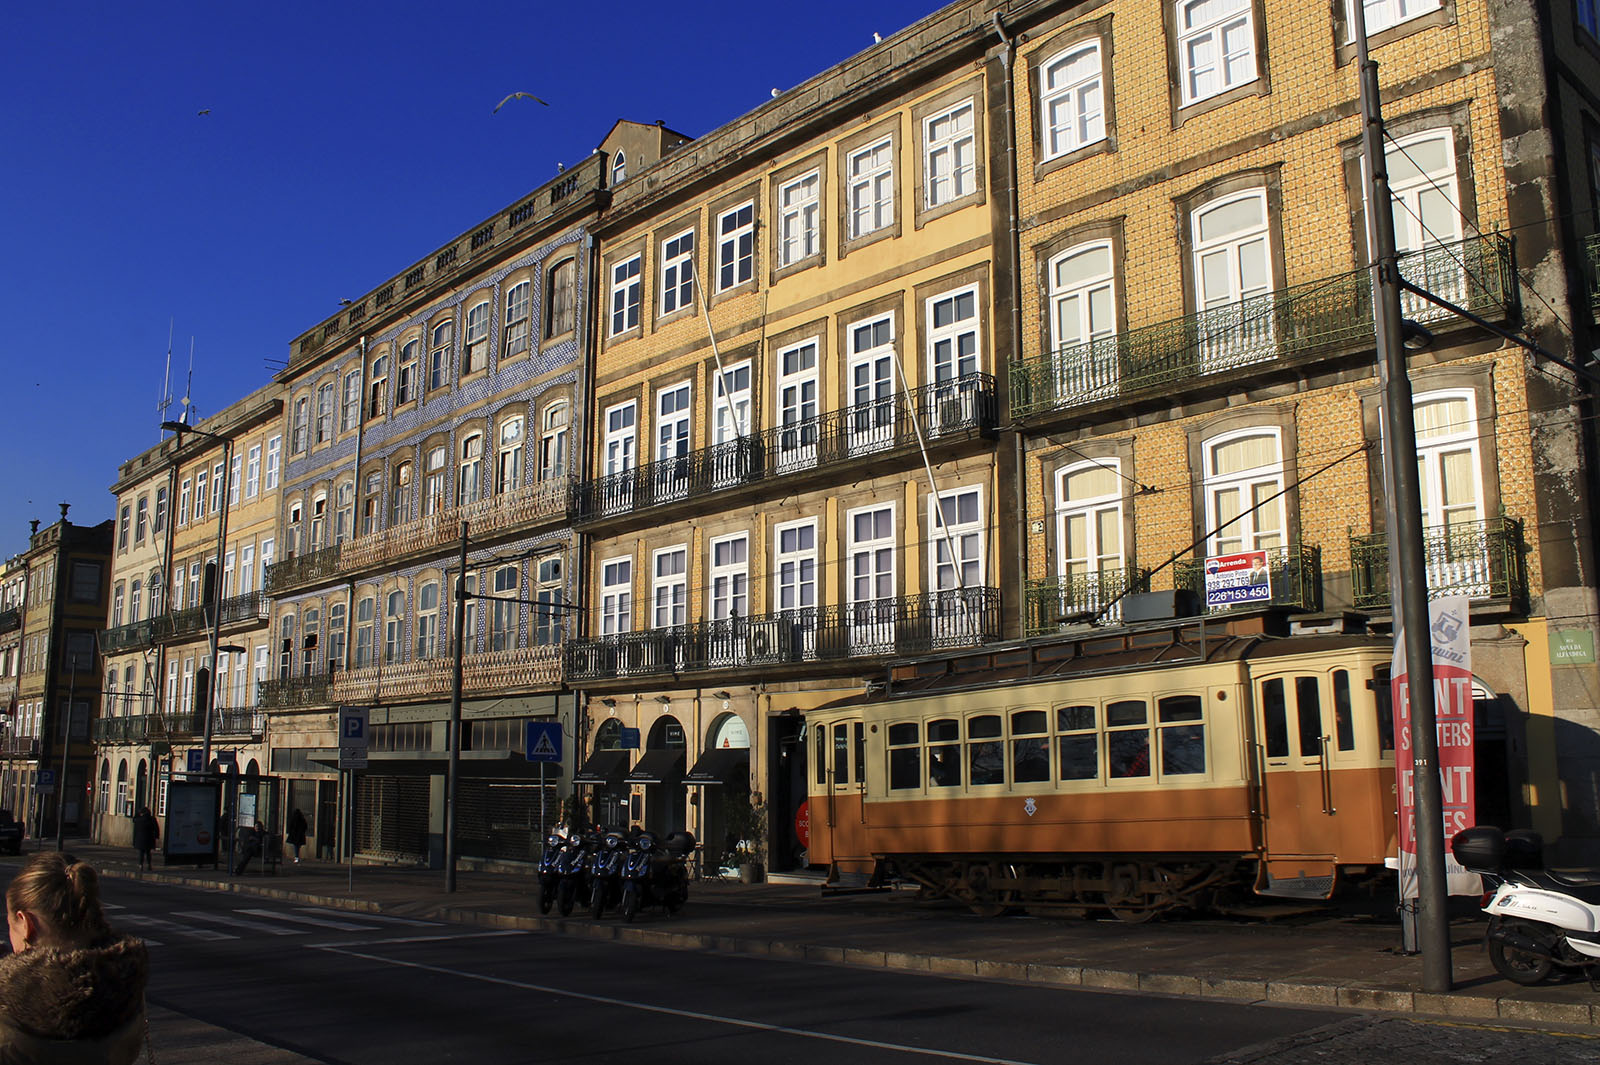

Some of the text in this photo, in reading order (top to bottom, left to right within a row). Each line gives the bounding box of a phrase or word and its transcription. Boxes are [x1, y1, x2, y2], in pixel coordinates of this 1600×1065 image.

[1219, 559, 1247, 568] Arrenda
[1222, 579, 1235, 588] 292
[1236, 576, 1249, 586] 769
[1209, 586, 1267, 602] 226 153 450
[1400, 677, 1469, 719] RNT
[347, 719, 360, 737] P
[1402, 766, 1471, 807] RNT
